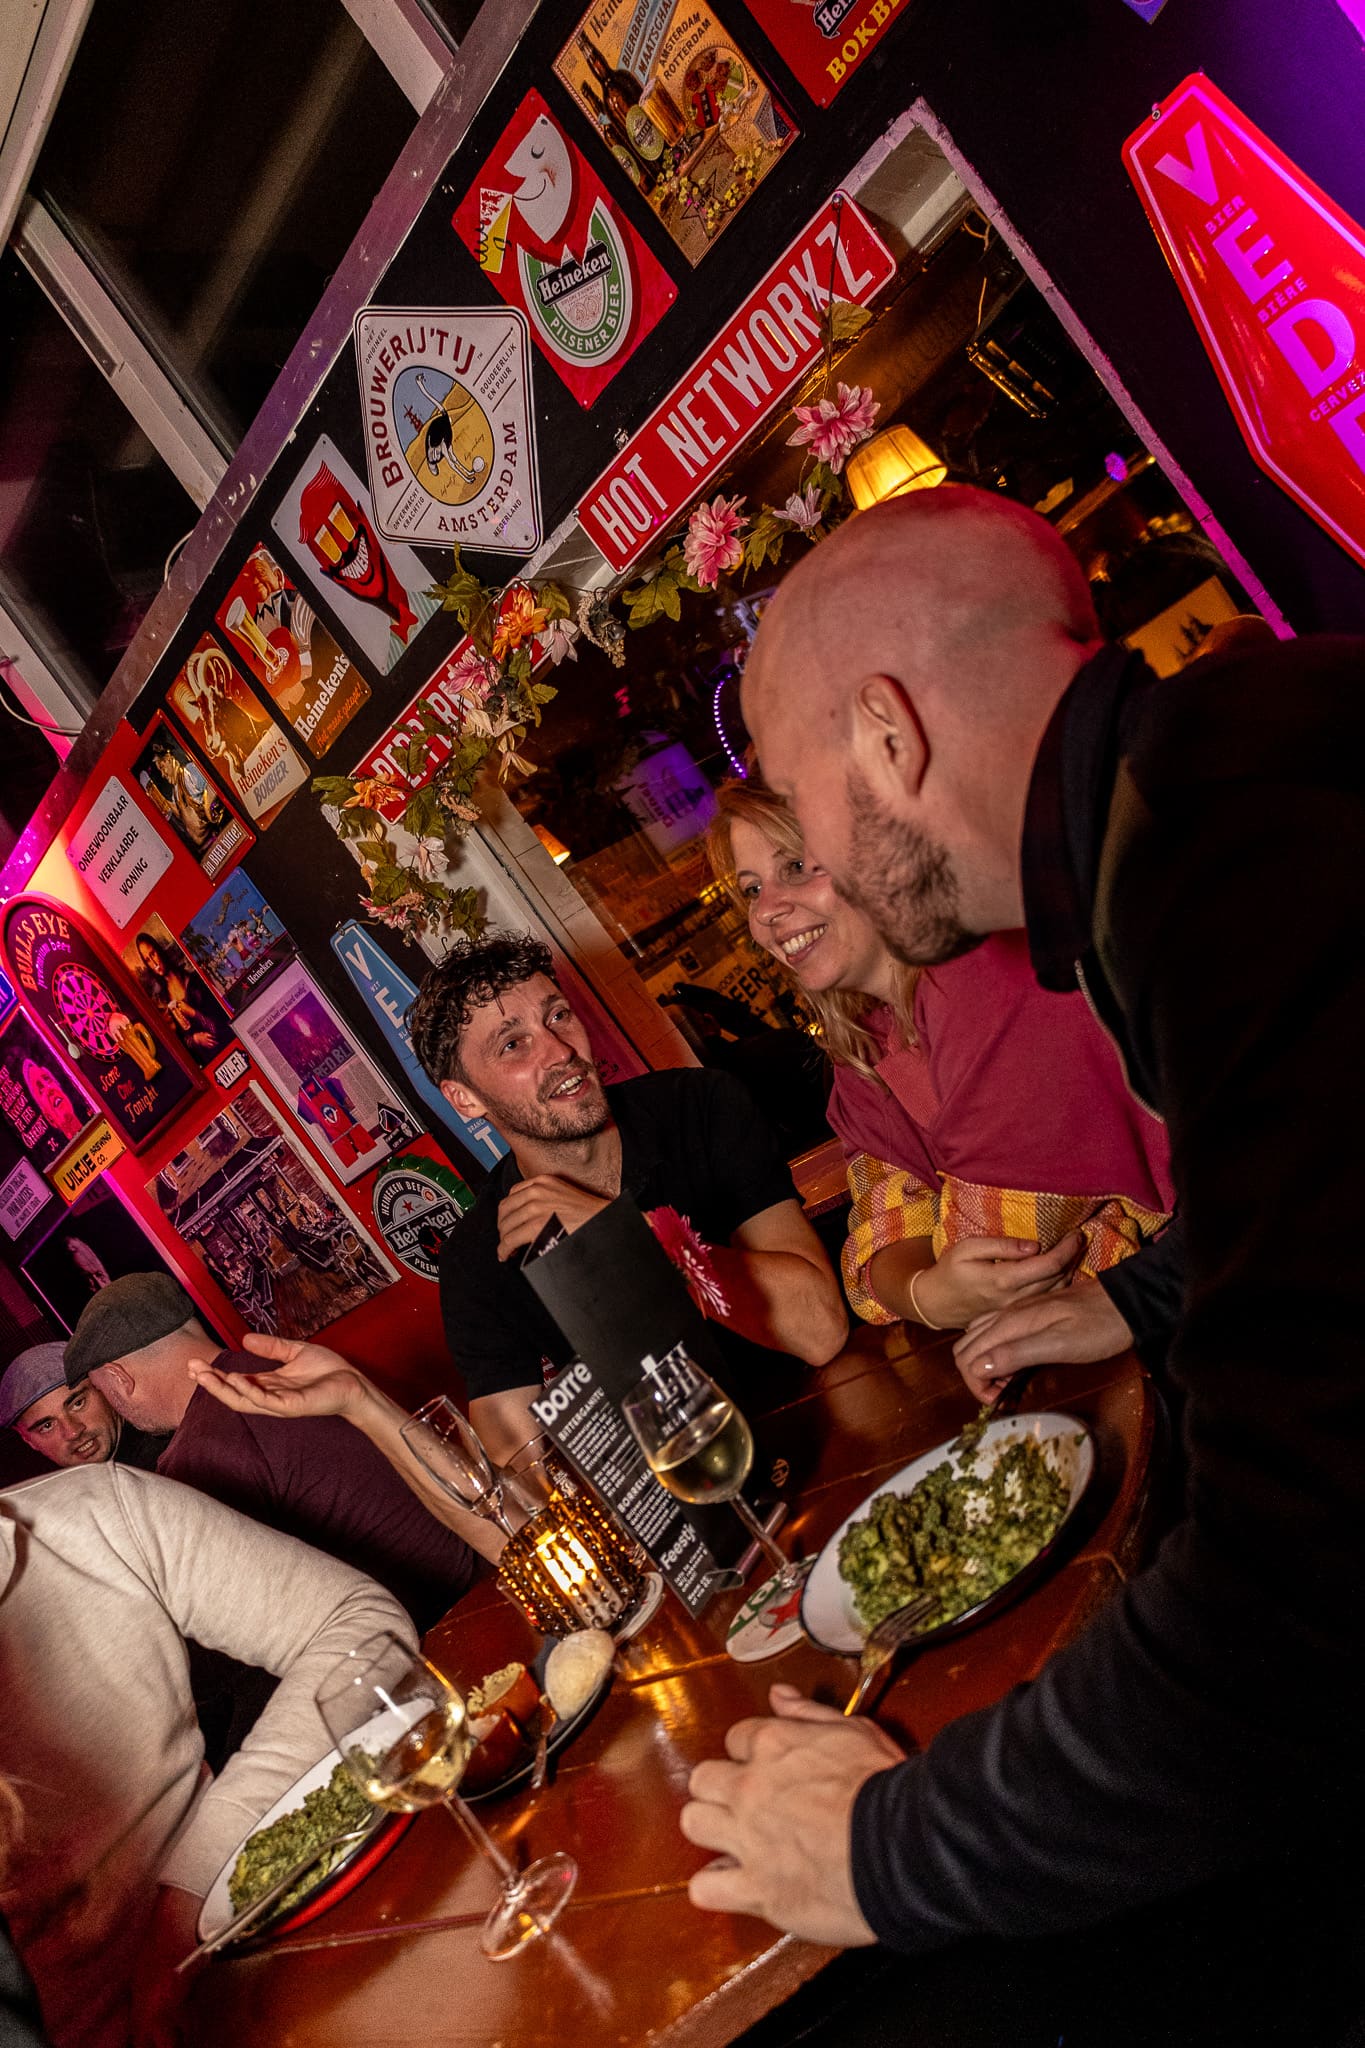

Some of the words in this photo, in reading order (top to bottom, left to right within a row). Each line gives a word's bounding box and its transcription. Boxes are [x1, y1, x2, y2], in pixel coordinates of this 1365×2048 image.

[589, 0, 623, 38] Hein
[637, 0, 672, 75] MAATSCHA
[659, 11, 701, 68] AMSTERDAM
[818, 0, 854, 32] Hei
[664, 18, 712, 81] ROTTERDAM
[826, 0, 900, 83] BOKB
[1204, 195, 1245, 235] BIER
[538, 252, 611, 302] Heineken
[1257, 276, 1308, 325] BIÈRE
[551, 316, 609, 351] PILSENER
[606, 283, 619, 329] BIER
[480, 343, 517, 394] GOUDEERLIJK
[488, 387, 498, 400] EN
[496, 366, 512, 391] PUUR
[590, 453, 669, 554] HOT
[657, 221, 873, 479] NETWORKZ
[438, 421, 518, 533] AMSTERDAM
[393, 487, 420, 531] ONVERWACHT
[403, 496, 425, 531] KRACHTIG
[493, 499, 522, 538] NEDERLAND
[294, 653, 350, 742] Heineken's
[237, 737, 289, 796] Heineken's
[252, 760, 290, 807] BOKBIER
[78, 794, 129, 872] ONBEWOONBAAR
[98, 825, 140, 885] VERKLAARDE
[207, 842, 226, 865] BIER
[219, 823, 241, 849] bitte!
[119, 857, 148, 897] WONING
[16, 920, 39, 992] BULL'S
[29, 912, 70, 940] EYE
[247, 959, 274, 985] Heineken
[101, 1066, 121, 1093] Score
[124, 1086, 159, 1124] Tonight
[91, 1130, 112, 1158] BREWING
[63, 1152, 97, 1191] UILTJE
[381, 1181, 404, 1216] HEINEKEN
[406, 1181, 422, 1192] BEE
[532, 1362, 592, 1426] borre
